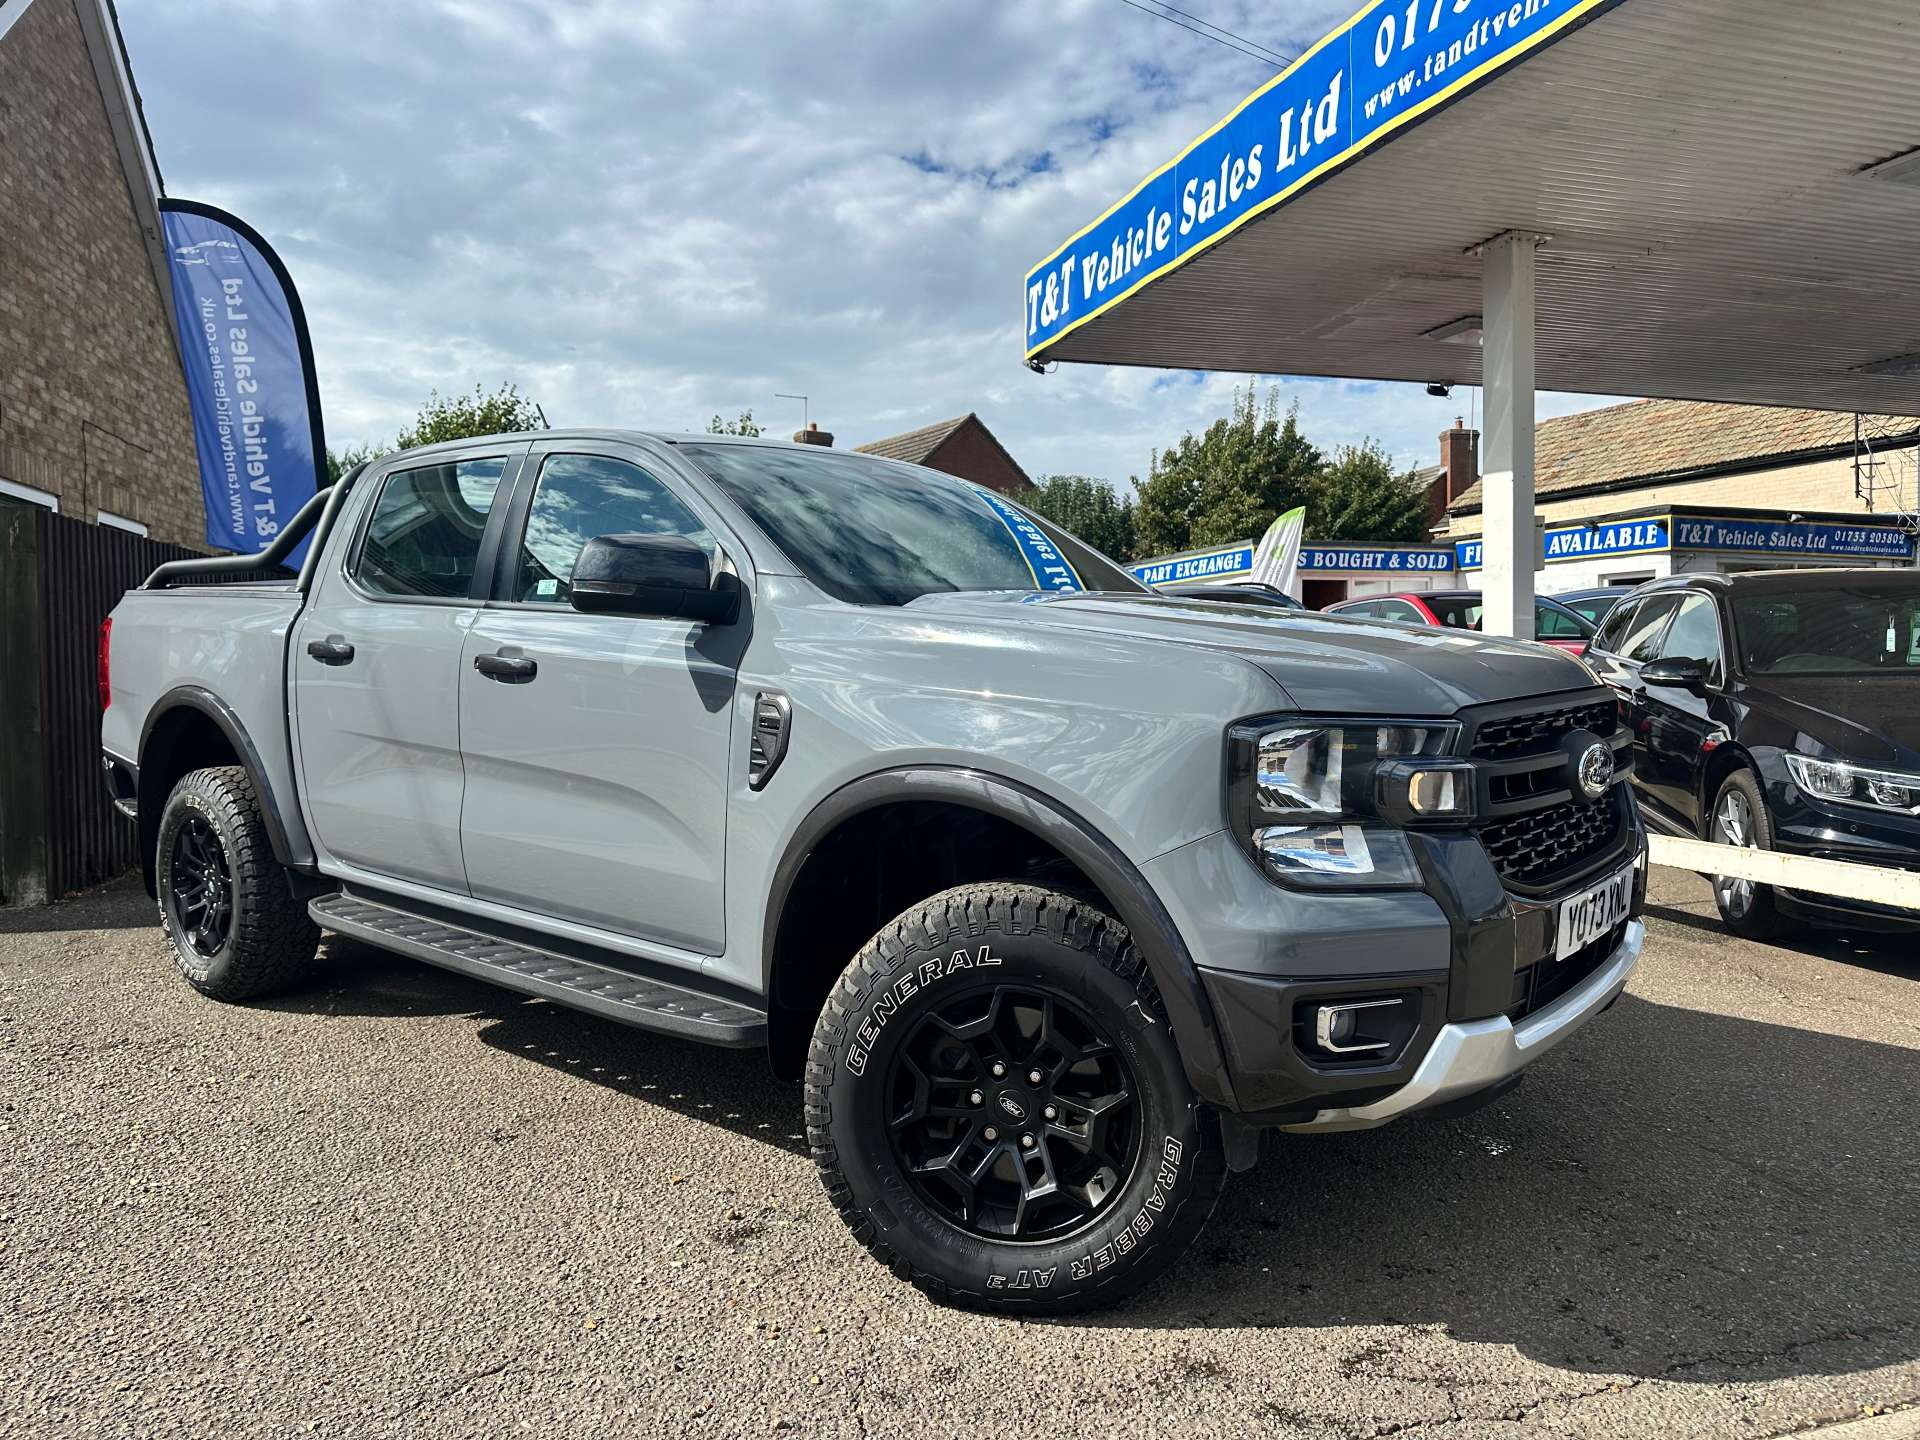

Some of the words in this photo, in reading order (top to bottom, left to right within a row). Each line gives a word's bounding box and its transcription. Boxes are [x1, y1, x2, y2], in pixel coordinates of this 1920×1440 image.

[1374, 0, 1471, 68] 017
[1027, 253, 1078, 338] T&T
[1081, 206, 1172, 300] Vehicle
[1178, 139, 1263, 236] Sales
[1275, 68, 1345, 174] Ltd
[1548, 523, 1658, 554] AVAILABLE
[1680, 523, 1715, 545] T&T
[1718, 528, 1765, 546] Vehicle
[1769, 530, 1804, 548] Sales
[1806, 533, 1828, 549] Ltd
[1143, 564, 1173, 583] PART
[1175, 552, 1243, 578] EXCHANGE
[1313, 552, 1385, 568] BOUGHT
[1389, 552, 1401, 568] &
[1406, 553, 1448, 570] SOLD
[1465, 545, 1483, 563] FI
[1568, 888, 1606, 948] YO73
[1605, 876, 1627, 925] XNL
[845, 945, 1002, 1077] GENERAL
[1070, 1135, 1183, 1281] GRABBER
[986, 1266, 1057, 1289] AT3
